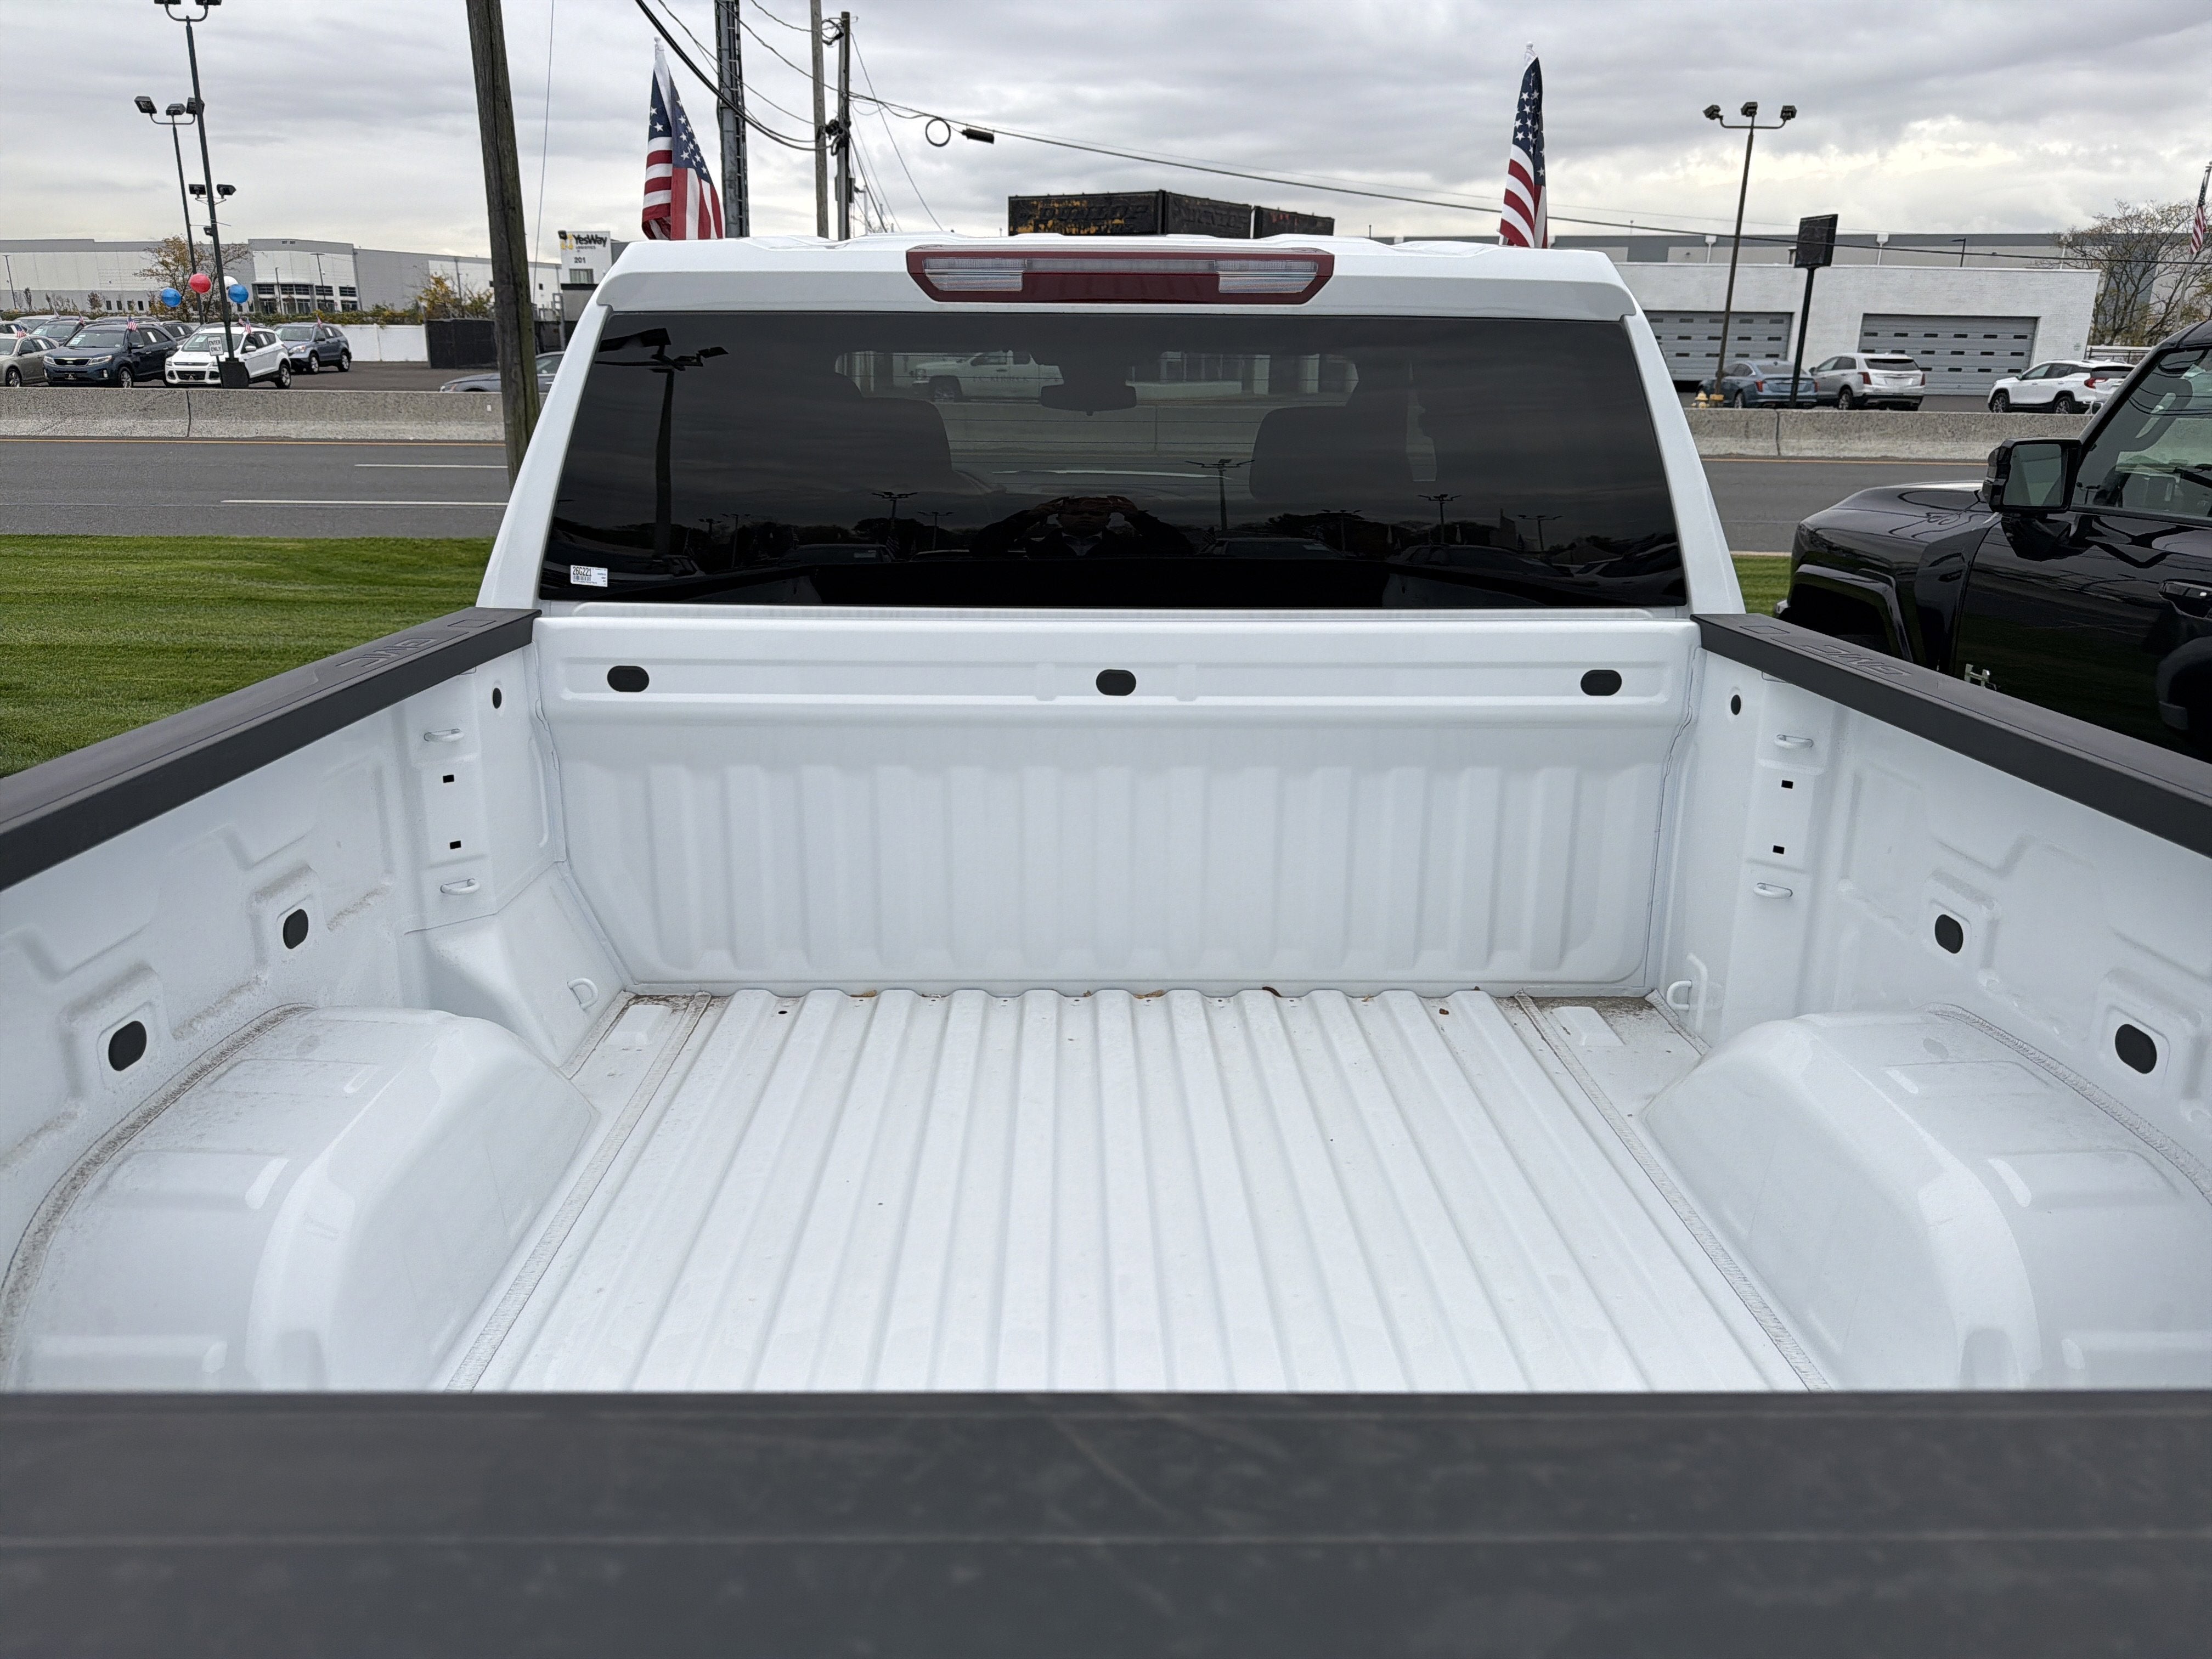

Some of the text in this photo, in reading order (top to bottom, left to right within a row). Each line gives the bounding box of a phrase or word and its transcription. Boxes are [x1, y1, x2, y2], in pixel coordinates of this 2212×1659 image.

[572, 234, 607, 247] YesWay
[572, 566, 592, 577] 26G221
[335, 638, 438, 668] GMC
[1802, 645, 1912, 676] GMC
